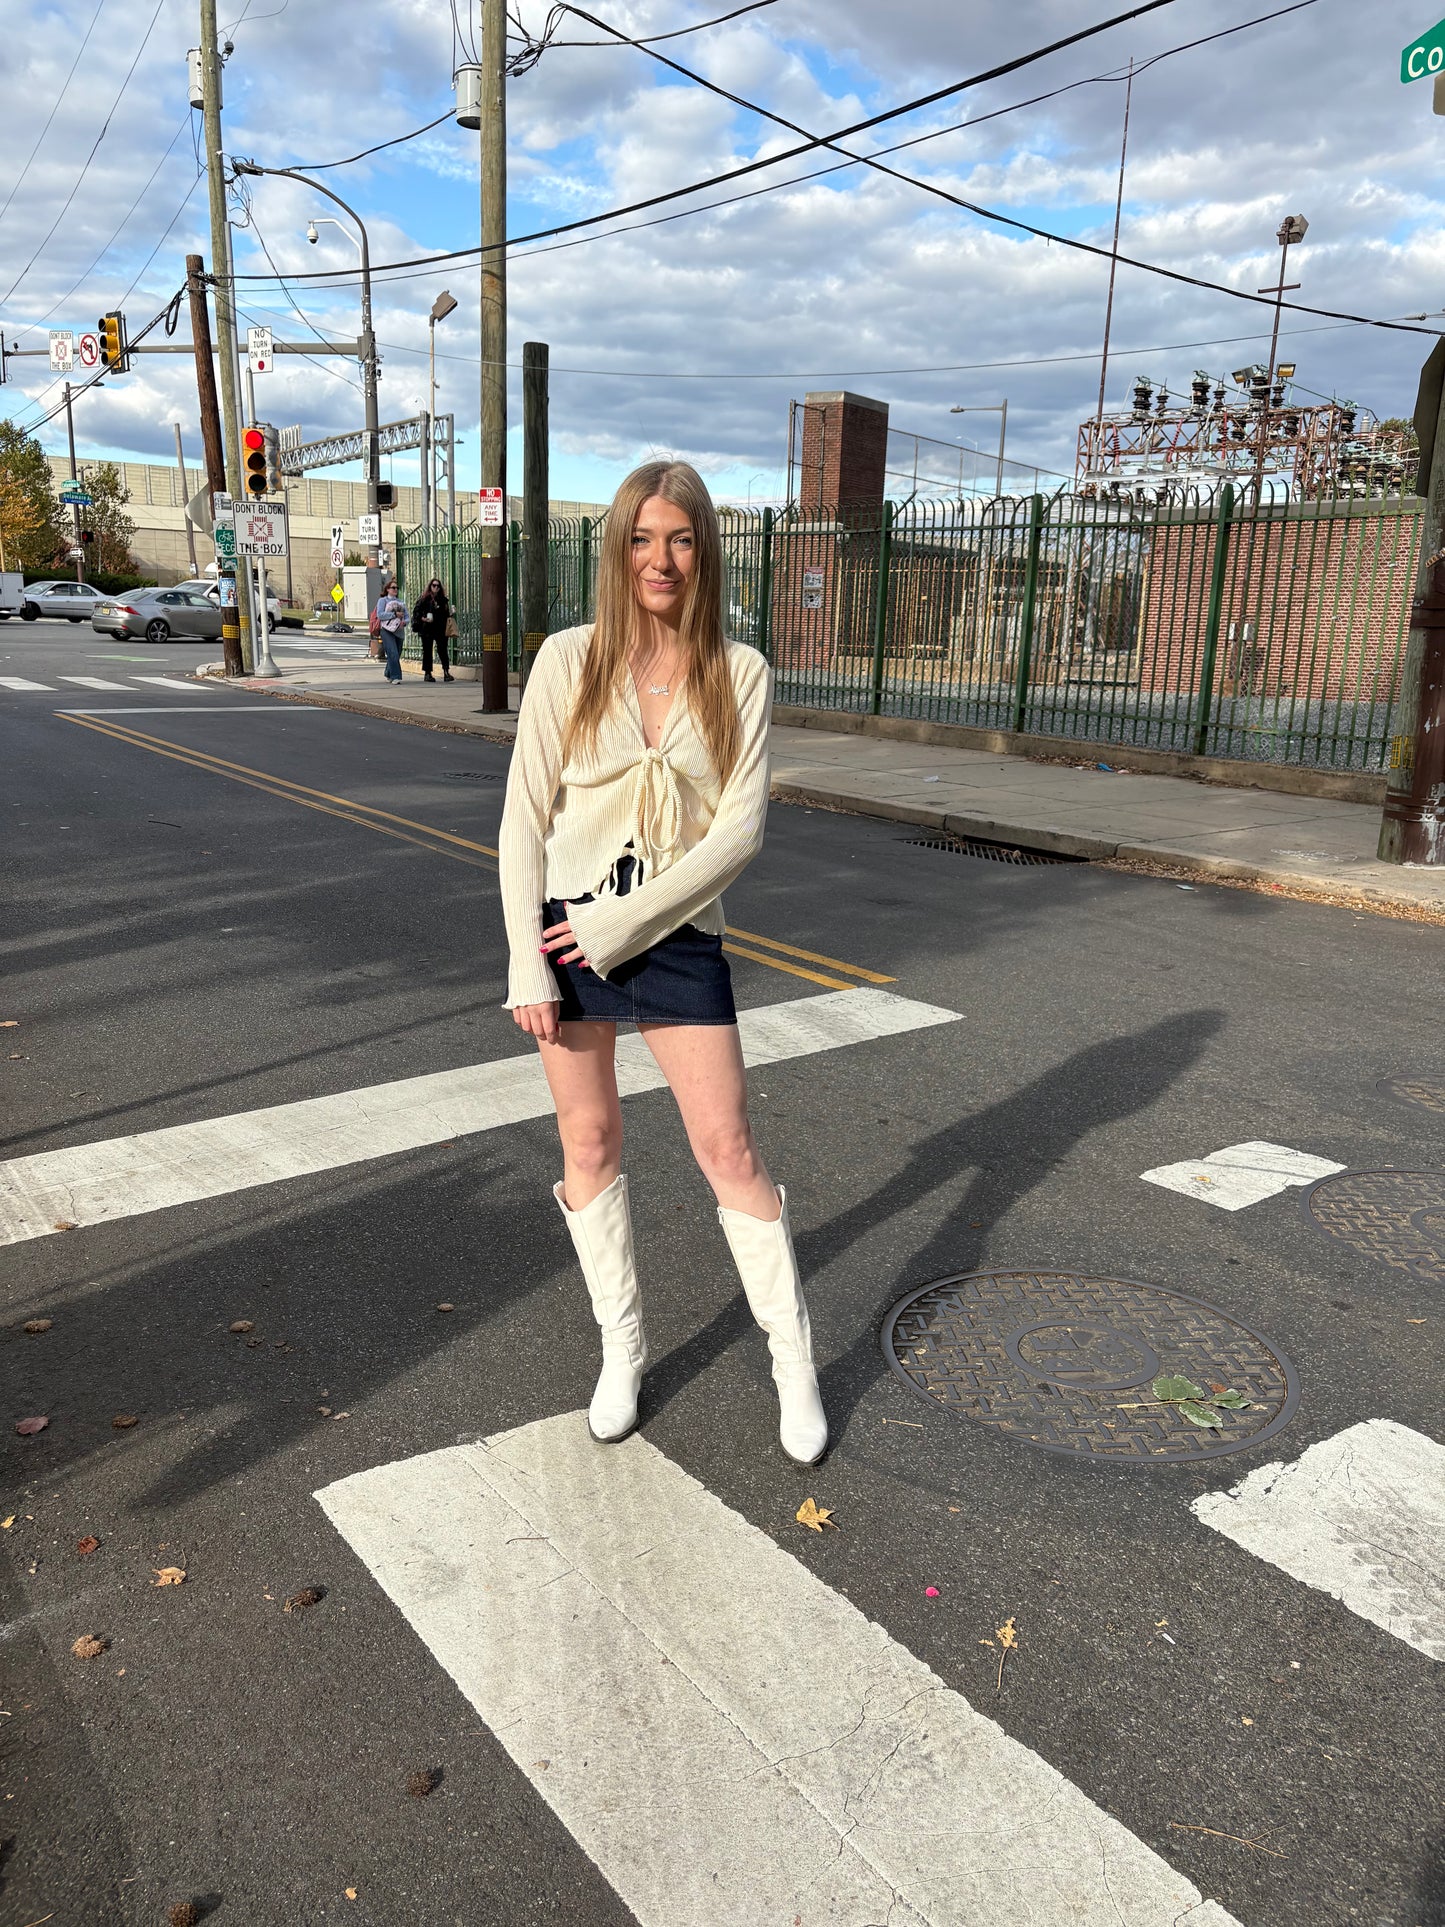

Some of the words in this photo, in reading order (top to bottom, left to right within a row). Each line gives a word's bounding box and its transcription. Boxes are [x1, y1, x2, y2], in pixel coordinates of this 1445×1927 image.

[50, 332, 60, 340] DONT
[60, 332, 72, 340] BLOCK
[254, 329, 265, 339] NO
[253, 340, 268, 349] TURN
[250, 351, 258, 359] ON
[260, 349, 271, 358] RED
[52, 362, 60, 370] THE
[62, 361, 72, 370] BOX
[486, 489, 496, 498] NO
[235, 503, 256, 514] DONT
[258, 503, 283, 515] BLOCK
[239, 543, 259, 554] THE
[263, 543, 284, 554] BOX
